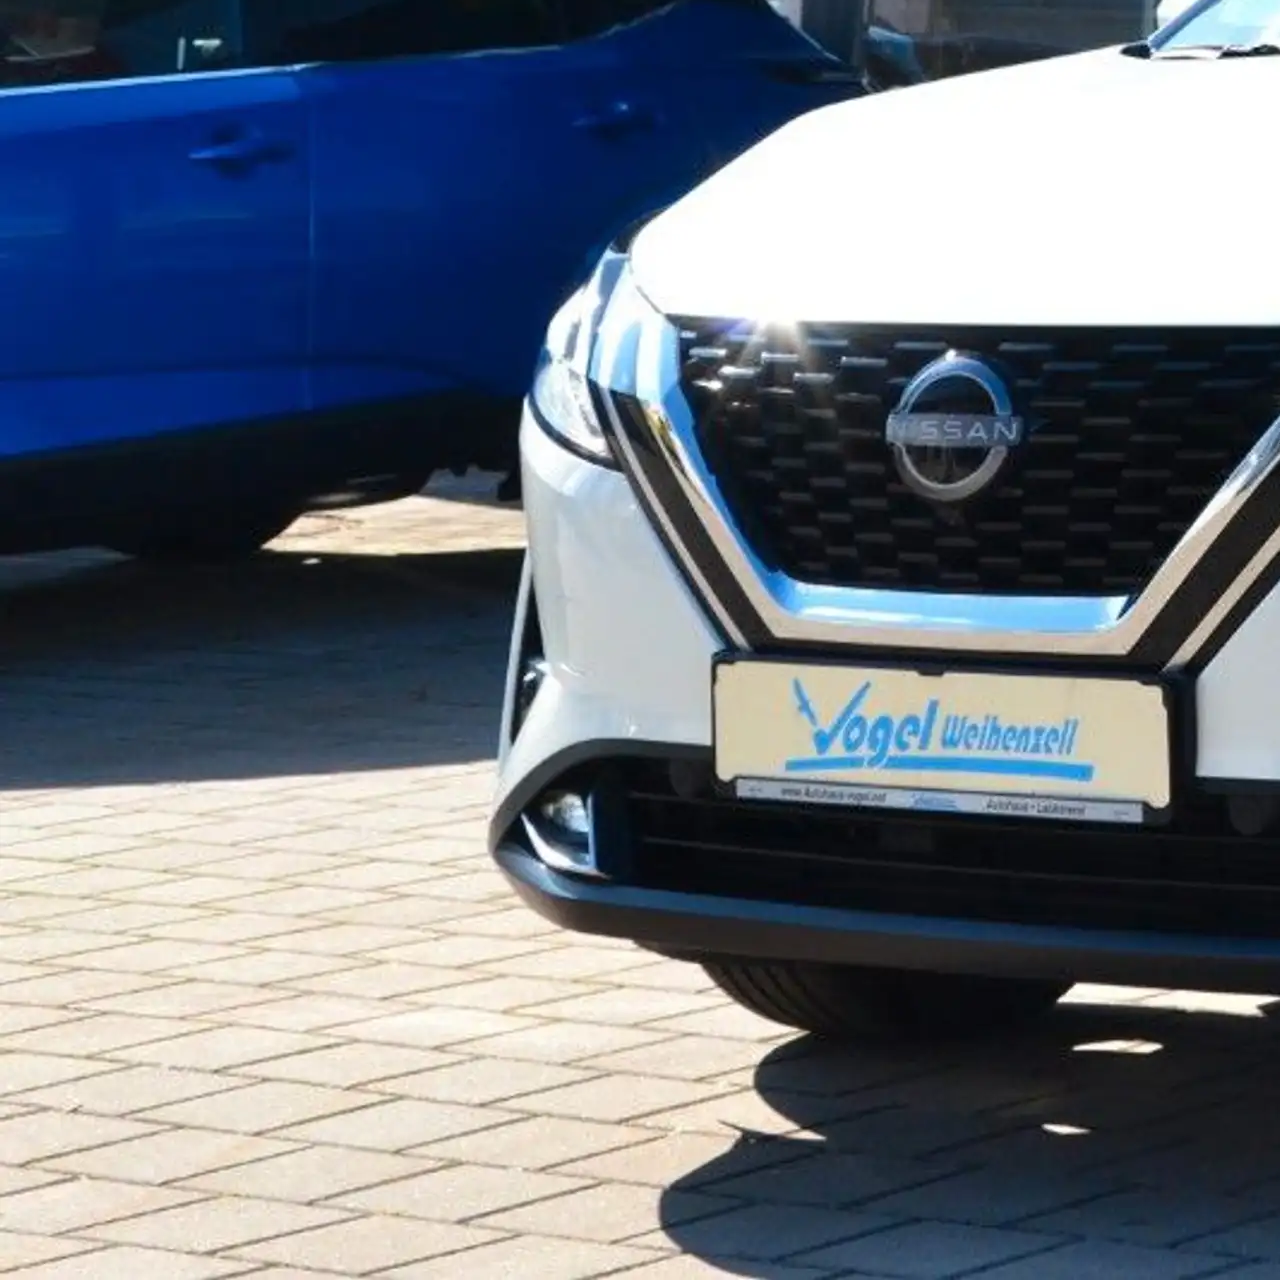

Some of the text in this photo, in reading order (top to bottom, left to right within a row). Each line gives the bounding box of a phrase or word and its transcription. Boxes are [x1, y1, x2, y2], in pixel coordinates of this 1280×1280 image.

[888, 417, 1018, 443] NSSAN
[793, 677, 1079, 766] Vogel Weihenzell
